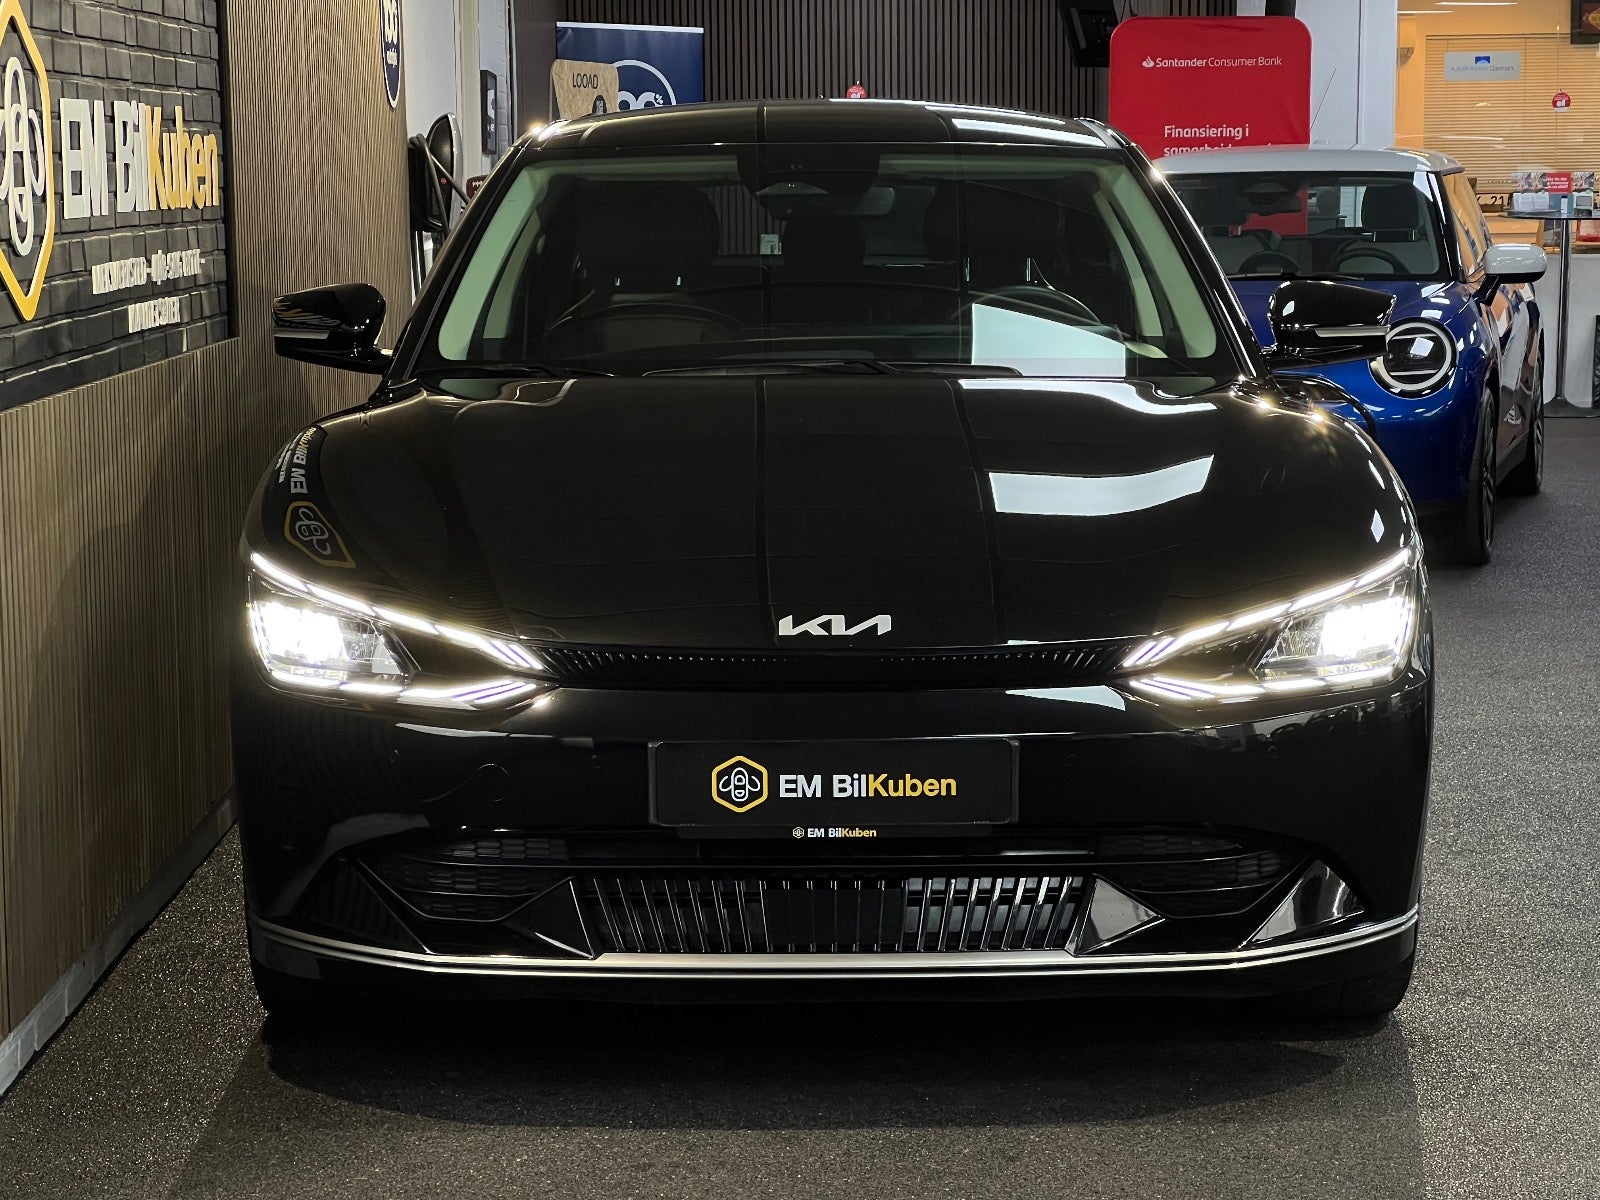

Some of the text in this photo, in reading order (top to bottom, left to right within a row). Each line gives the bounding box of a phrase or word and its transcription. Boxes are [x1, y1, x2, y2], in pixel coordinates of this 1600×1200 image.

[1156, 56, 1282, 68] Santander Consumer Bank
[572, 72, 599, 89] LOOAD
[1164, 123, 1250, 140] Finansiering i
[60, 98, 219, 219] EM BilKuben
[779, 773, 957, 798] EM BilKuben
[807, 827, 877, 838] EM BilKuben
